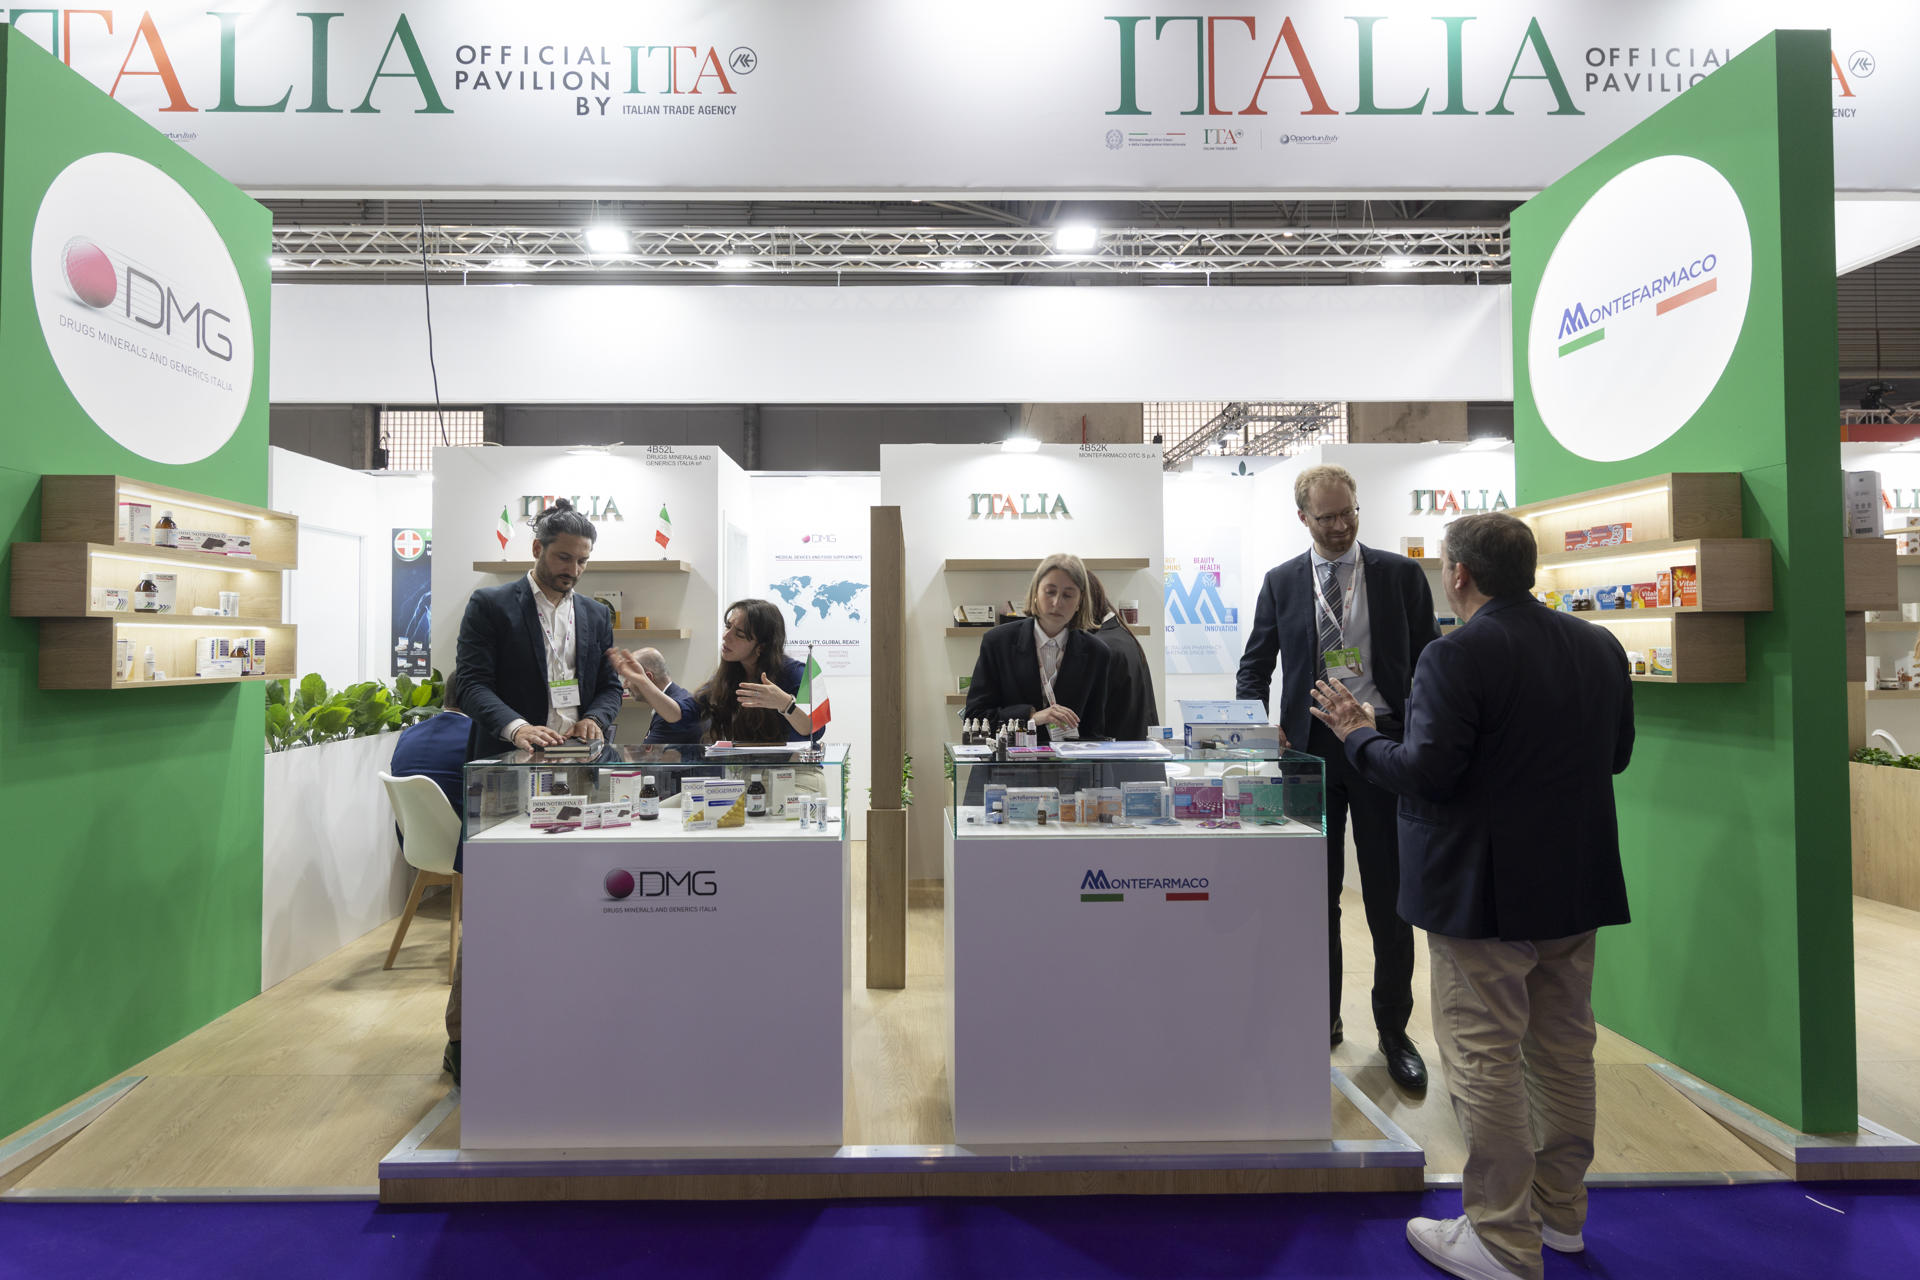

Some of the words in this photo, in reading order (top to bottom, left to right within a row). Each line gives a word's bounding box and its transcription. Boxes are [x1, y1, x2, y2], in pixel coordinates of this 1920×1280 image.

[0, 9, 454, 114] TALIA
[456, 45, 611, 66] OFFICIAL
[1104, 16, 1585, 115] ITALIA
[624, 46, 737, 94] ITA
[455, 71, 611, 91] PAVILION
[576, 97, 611, 116] BY
[623, 105, 660, 115] ITALIAN
[663, 105, 695, 115] TRADE
[698, 105, 737, 115] AGENCY
[1203, 129, 1237, 144] ITA
[1558, 253, 1717, 340] MONTEFARMACO
[126, 266, 233, 361] DMG
[59, 314, 96, 338] DRUGS
[98, 330, 148, 359] MINERALS
[149, 351, 168, 367] AND
[169, 359, 209, 384] GENERICS
[210, 376, 233, 392] ITALIA
[647, 445, 675, 454] 4B52L
[1079, 443, 1108, 452] 4B52K
[521, 495, 621, 517] ITLIA
[970, 493, 1070, 515] ITALIA
[1414, 489, 1509, 511] ITALIA
[811, 534, 837, 543] DMG
[1193, 556, 1215, 564] BEAUTY
[639, 870, 717, 896] DMG
[1080, 869, 1209, 890] MONTEFARMACO
[603, 906, 624, 914] DRUGS
[624, 906, 654, 914] MINERALS
[699, 905, 717, 913] ITALIA
